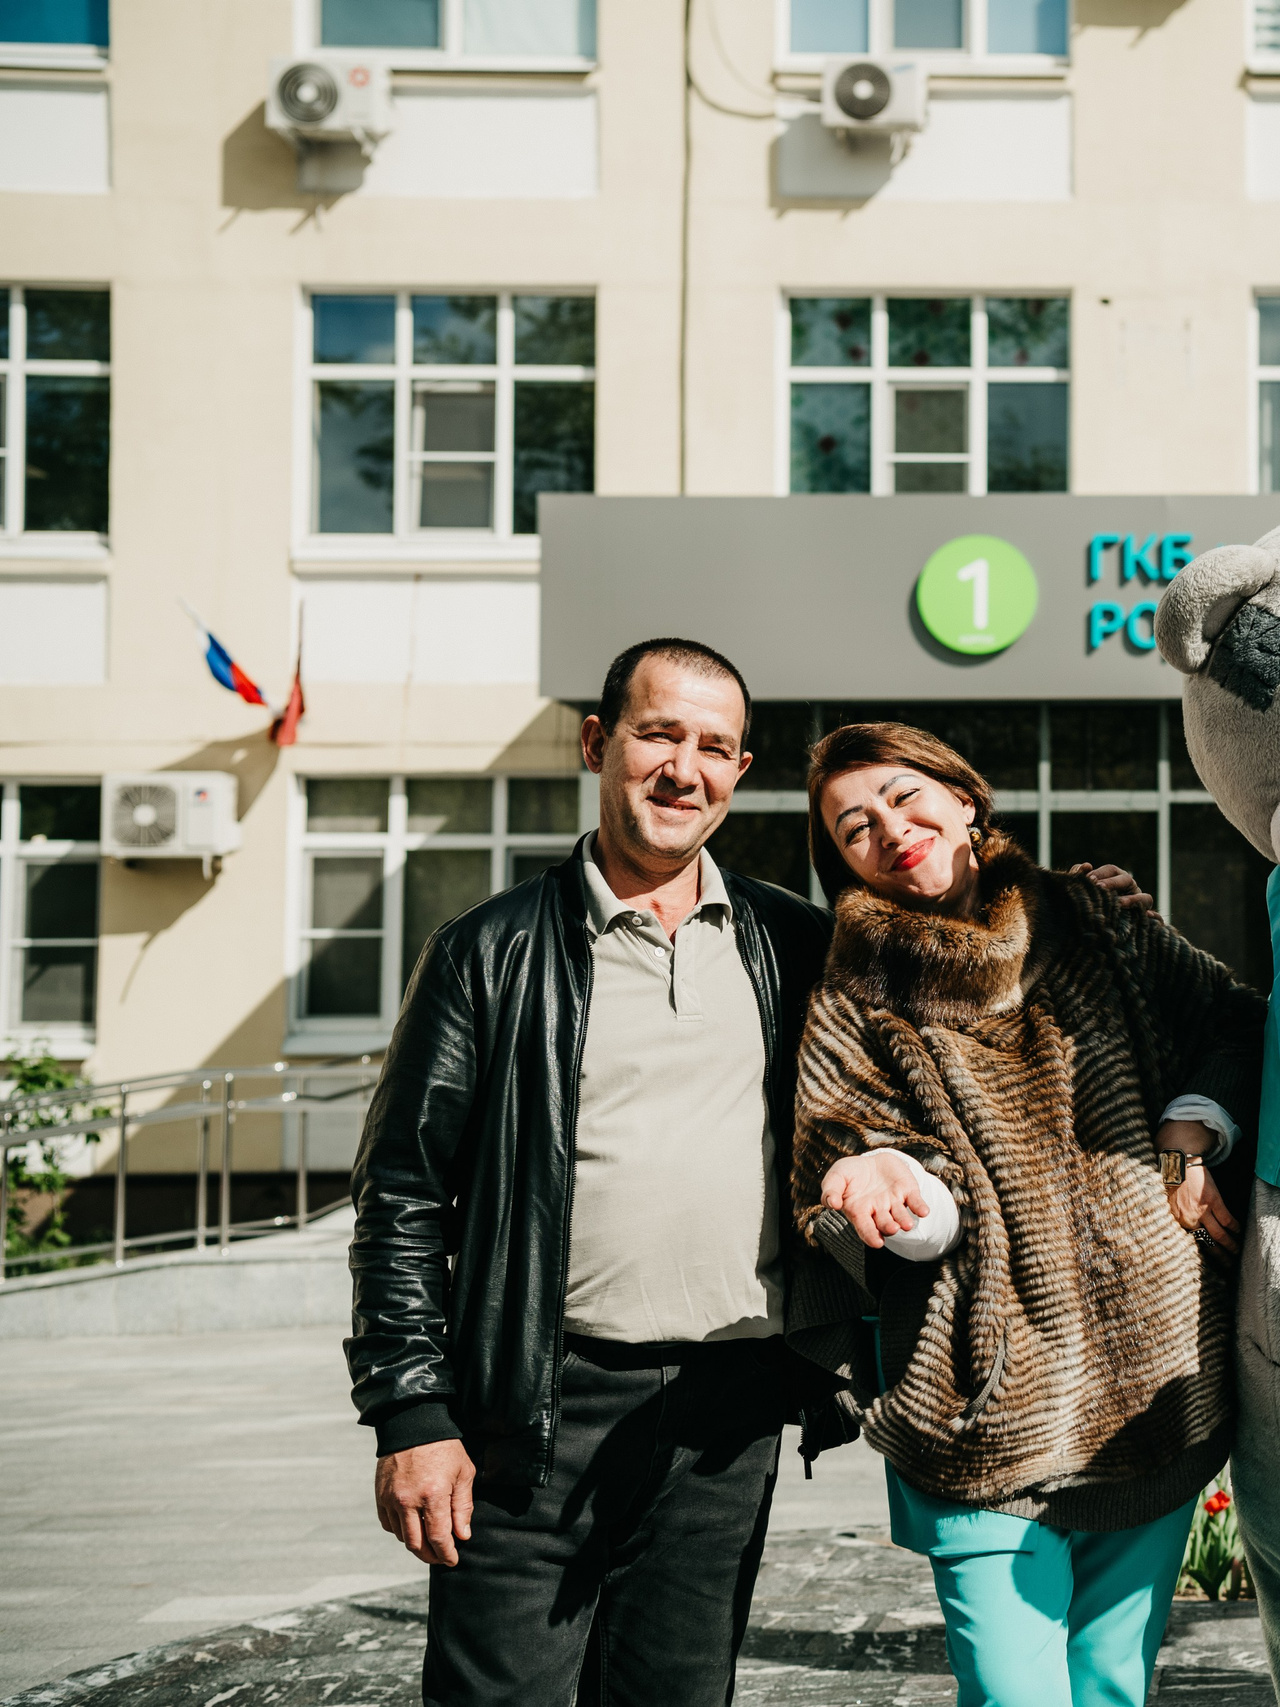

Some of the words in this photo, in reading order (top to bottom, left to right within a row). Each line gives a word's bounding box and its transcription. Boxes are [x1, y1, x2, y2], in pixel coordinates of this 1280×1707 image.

[1090, 533, 1194, 581] ГКБ
[957, 557, 989, 630] 1
[1090, 601, 1157, 650] РО
